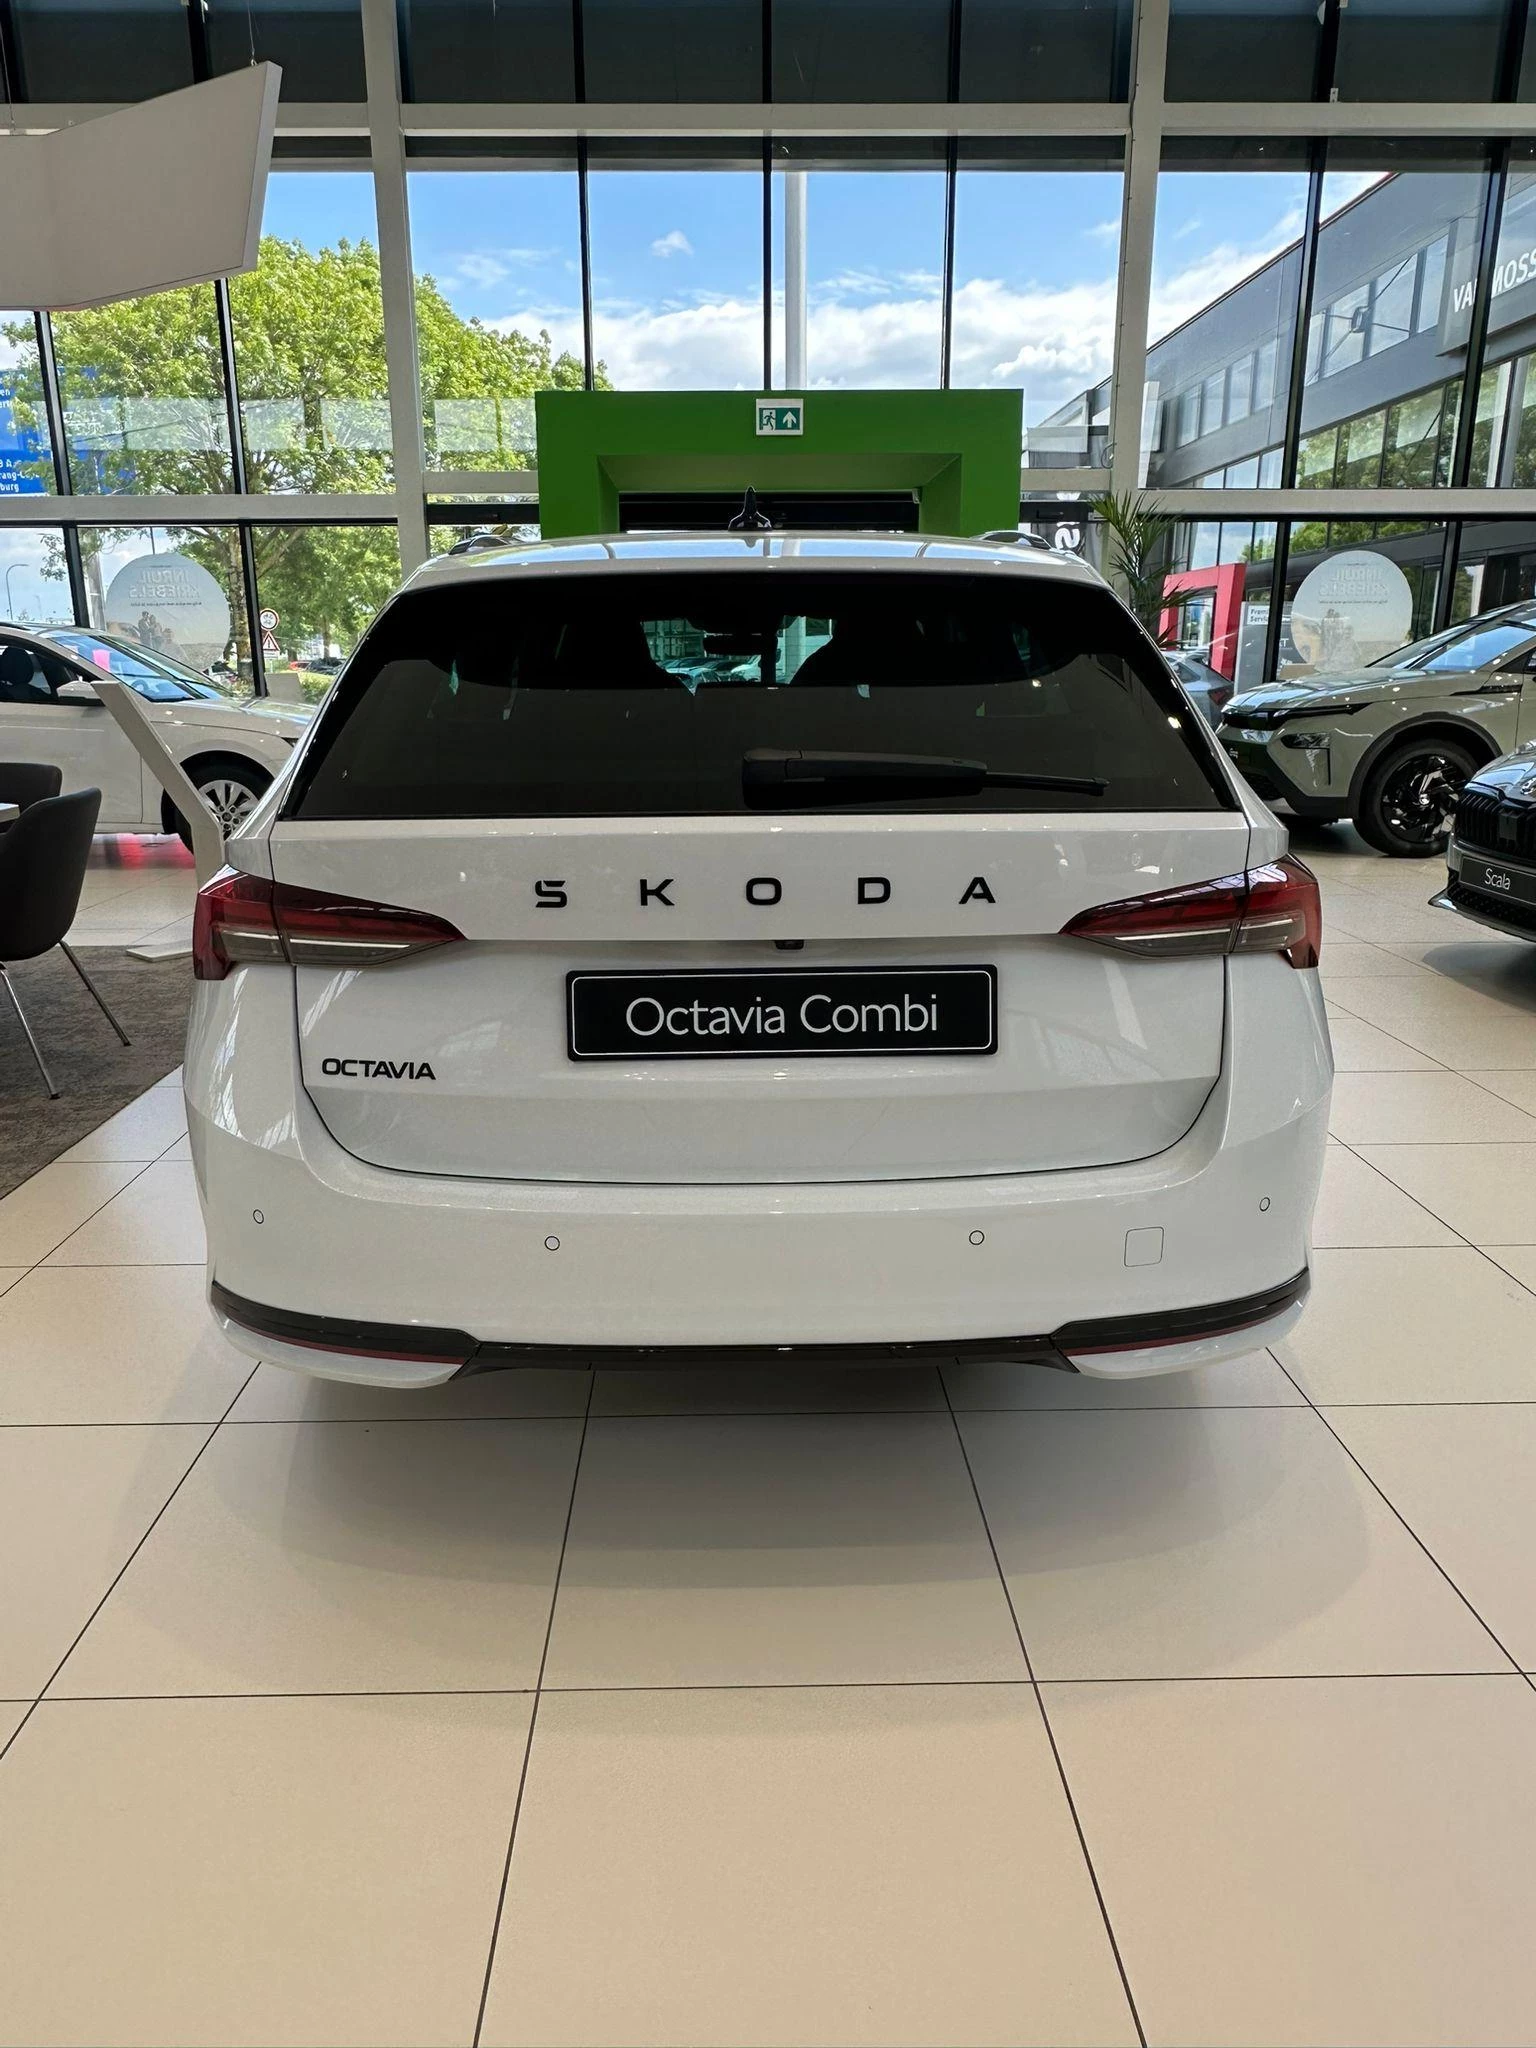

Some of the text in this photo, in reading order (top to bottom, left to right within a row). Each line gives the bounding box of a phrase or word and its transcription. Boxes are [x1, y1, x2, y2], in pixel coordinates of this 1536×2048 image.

[1453, 278, 1478, 313] VA
[534, 876, 997, 909] SKODA
[1484, 868, 1511, 890] Scala
[625, 993, 938, 1036] Octavia Combi
[321, 1057, 437, 1081] OCTAVIA
